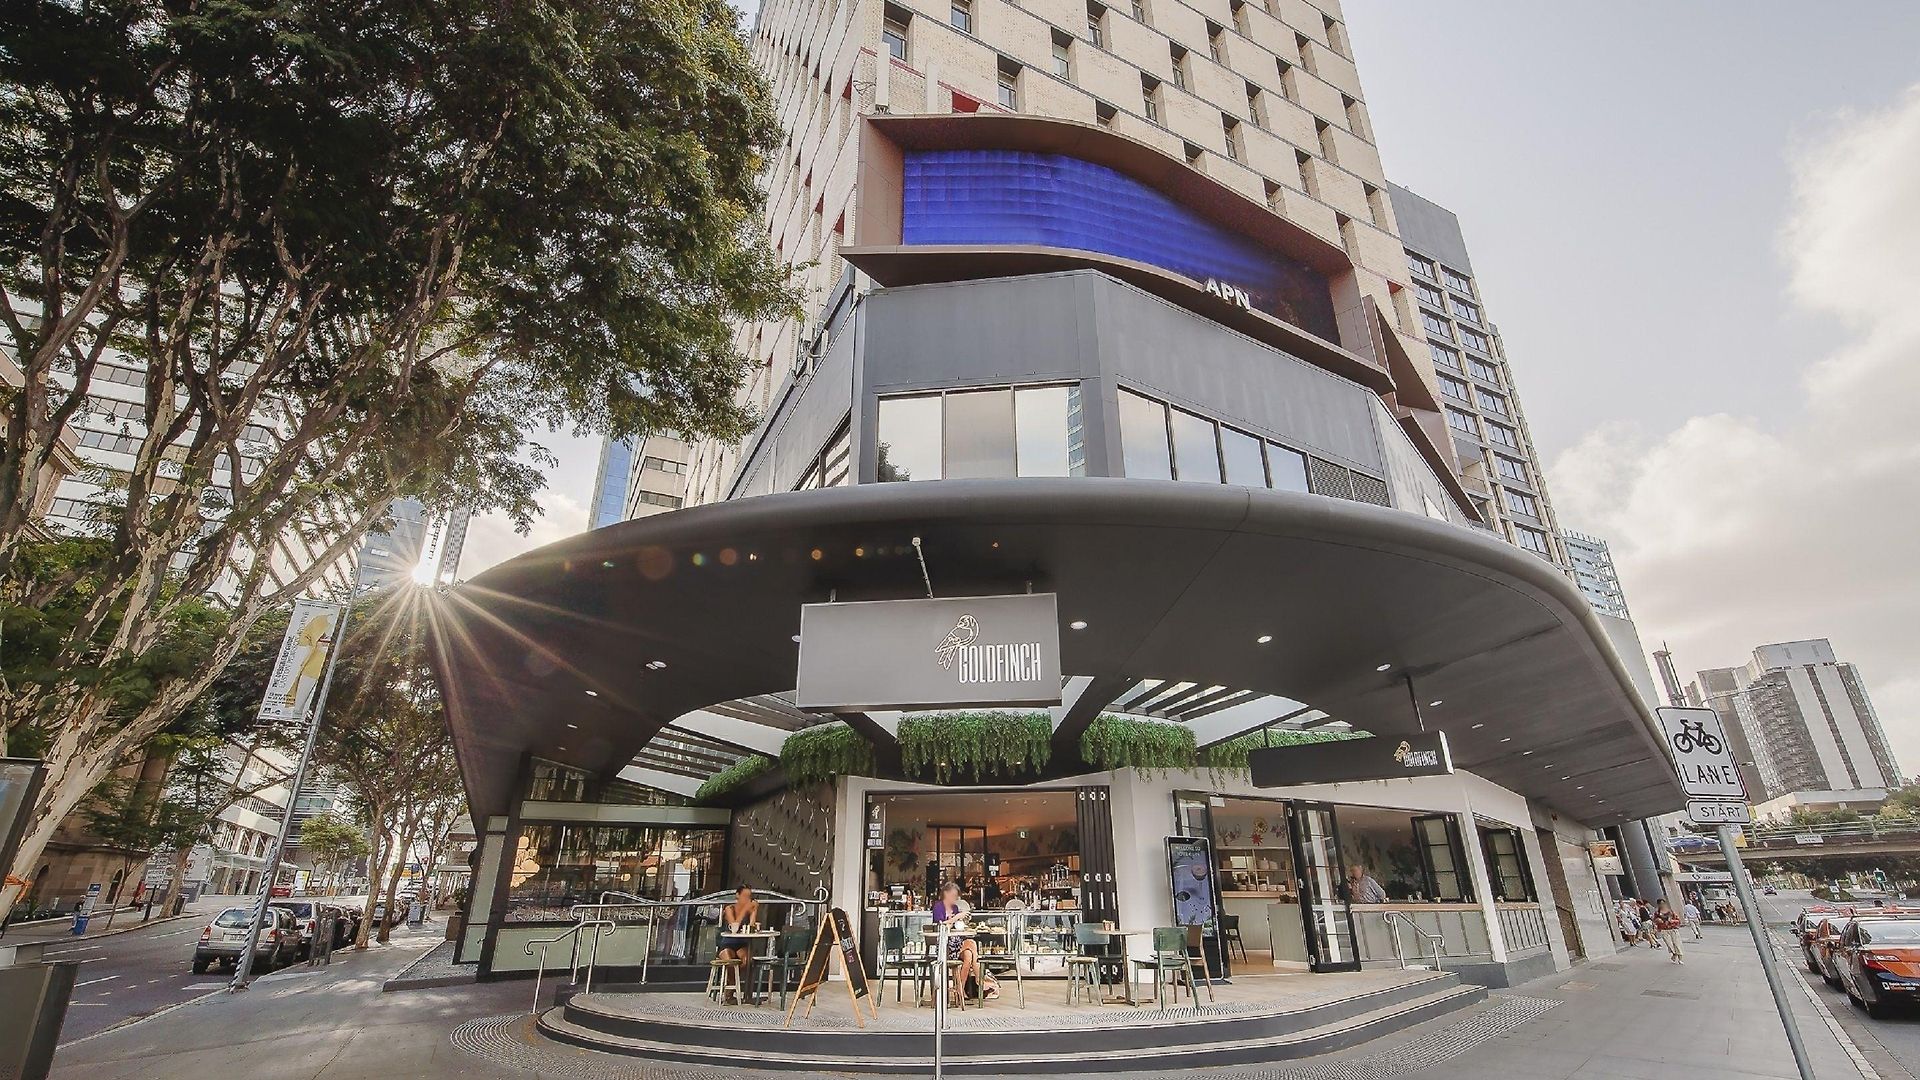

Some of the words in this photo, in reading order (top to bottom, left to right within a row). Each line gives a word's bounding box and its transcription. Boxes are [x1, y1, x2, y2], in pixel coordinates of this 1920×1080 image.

[1206, 278, 1250, 310] APN
[958, 642, 1041, 683] GOLDFINCH
[1681, 763, 1736, 785] LANE
[1700, 806, 1742, 818] START
